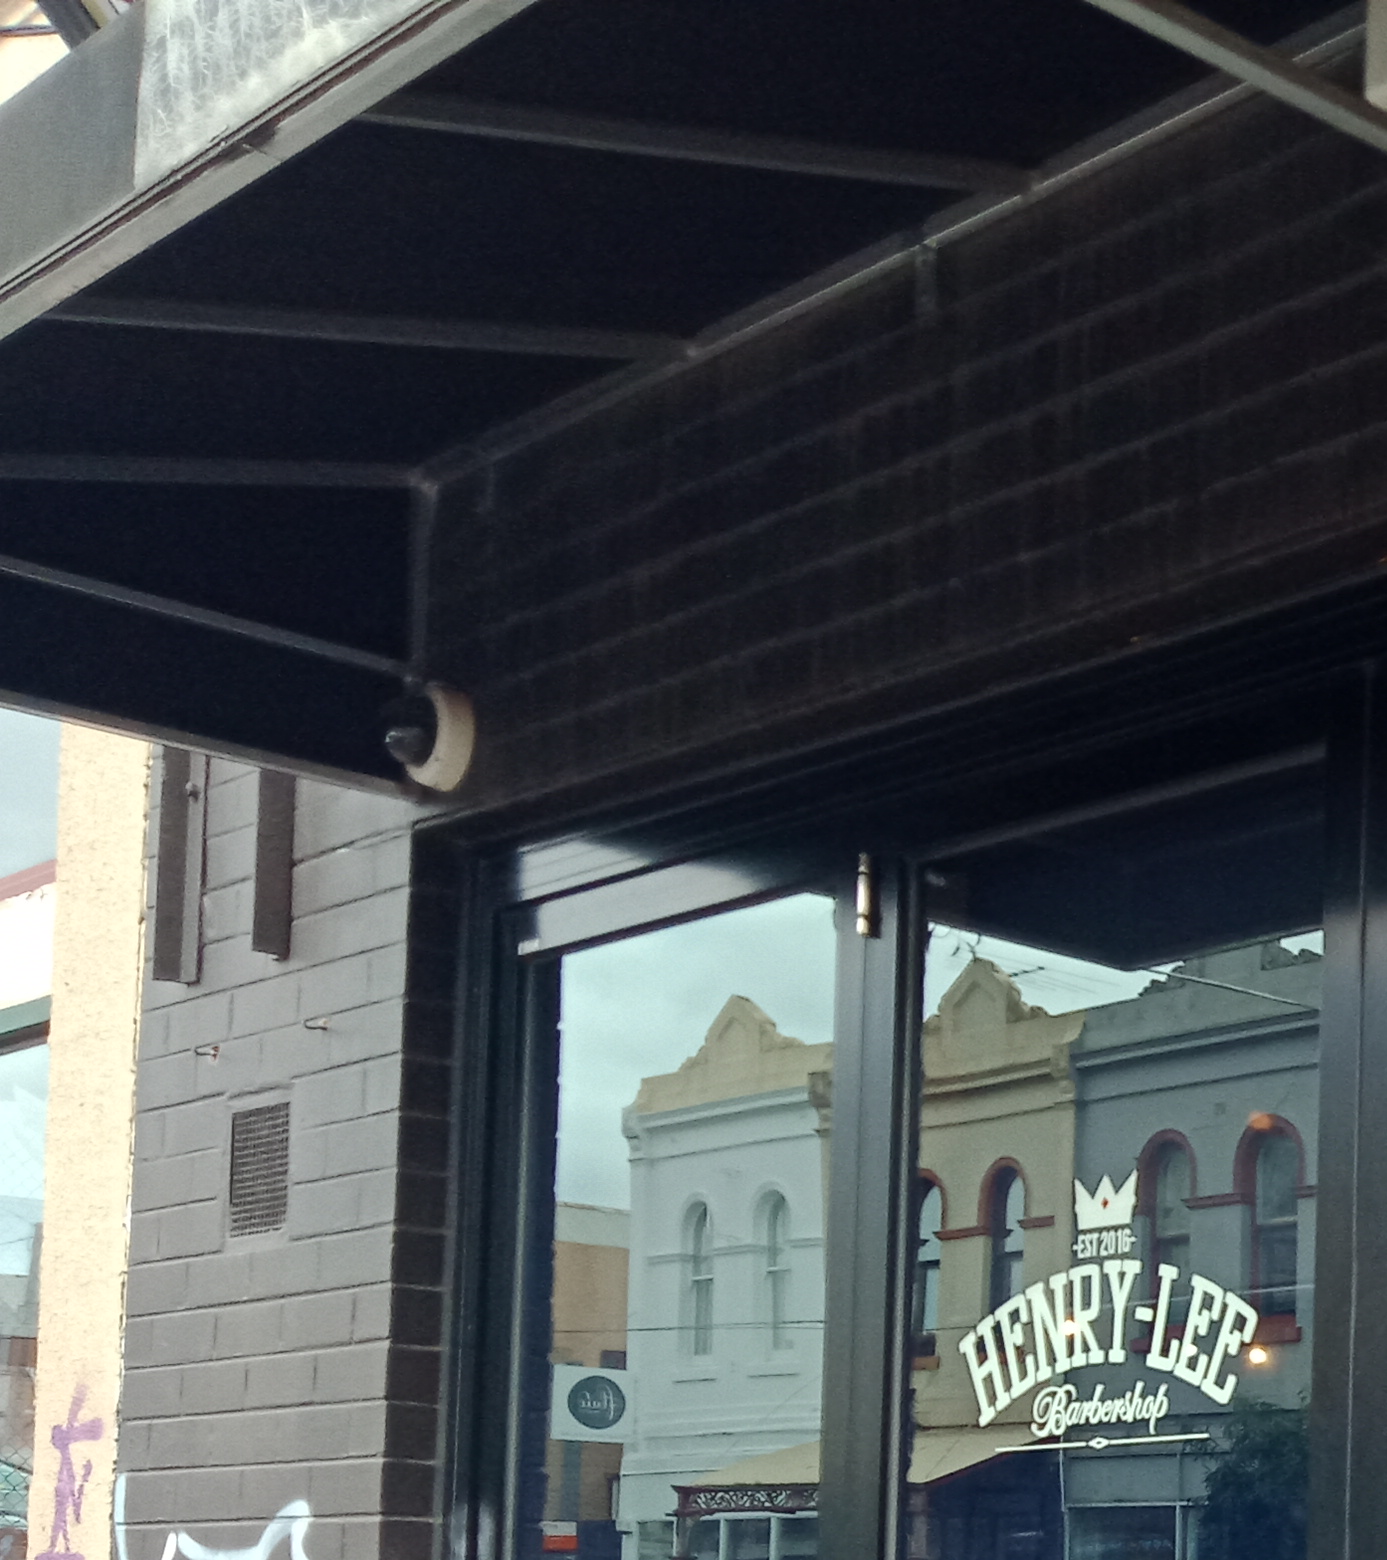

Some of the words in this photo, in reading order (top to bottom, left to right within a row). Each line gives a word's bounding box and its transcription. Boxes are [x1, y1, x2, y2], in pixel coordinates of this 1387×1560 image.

[1077, 1232, 1100, 1259] EST
[1100, 1227, 1132, 1255] 2016
[957, 1258, 1259, 1428] HENRY-LEE
[1030, 1380, 1170, 1438] Barbershop
